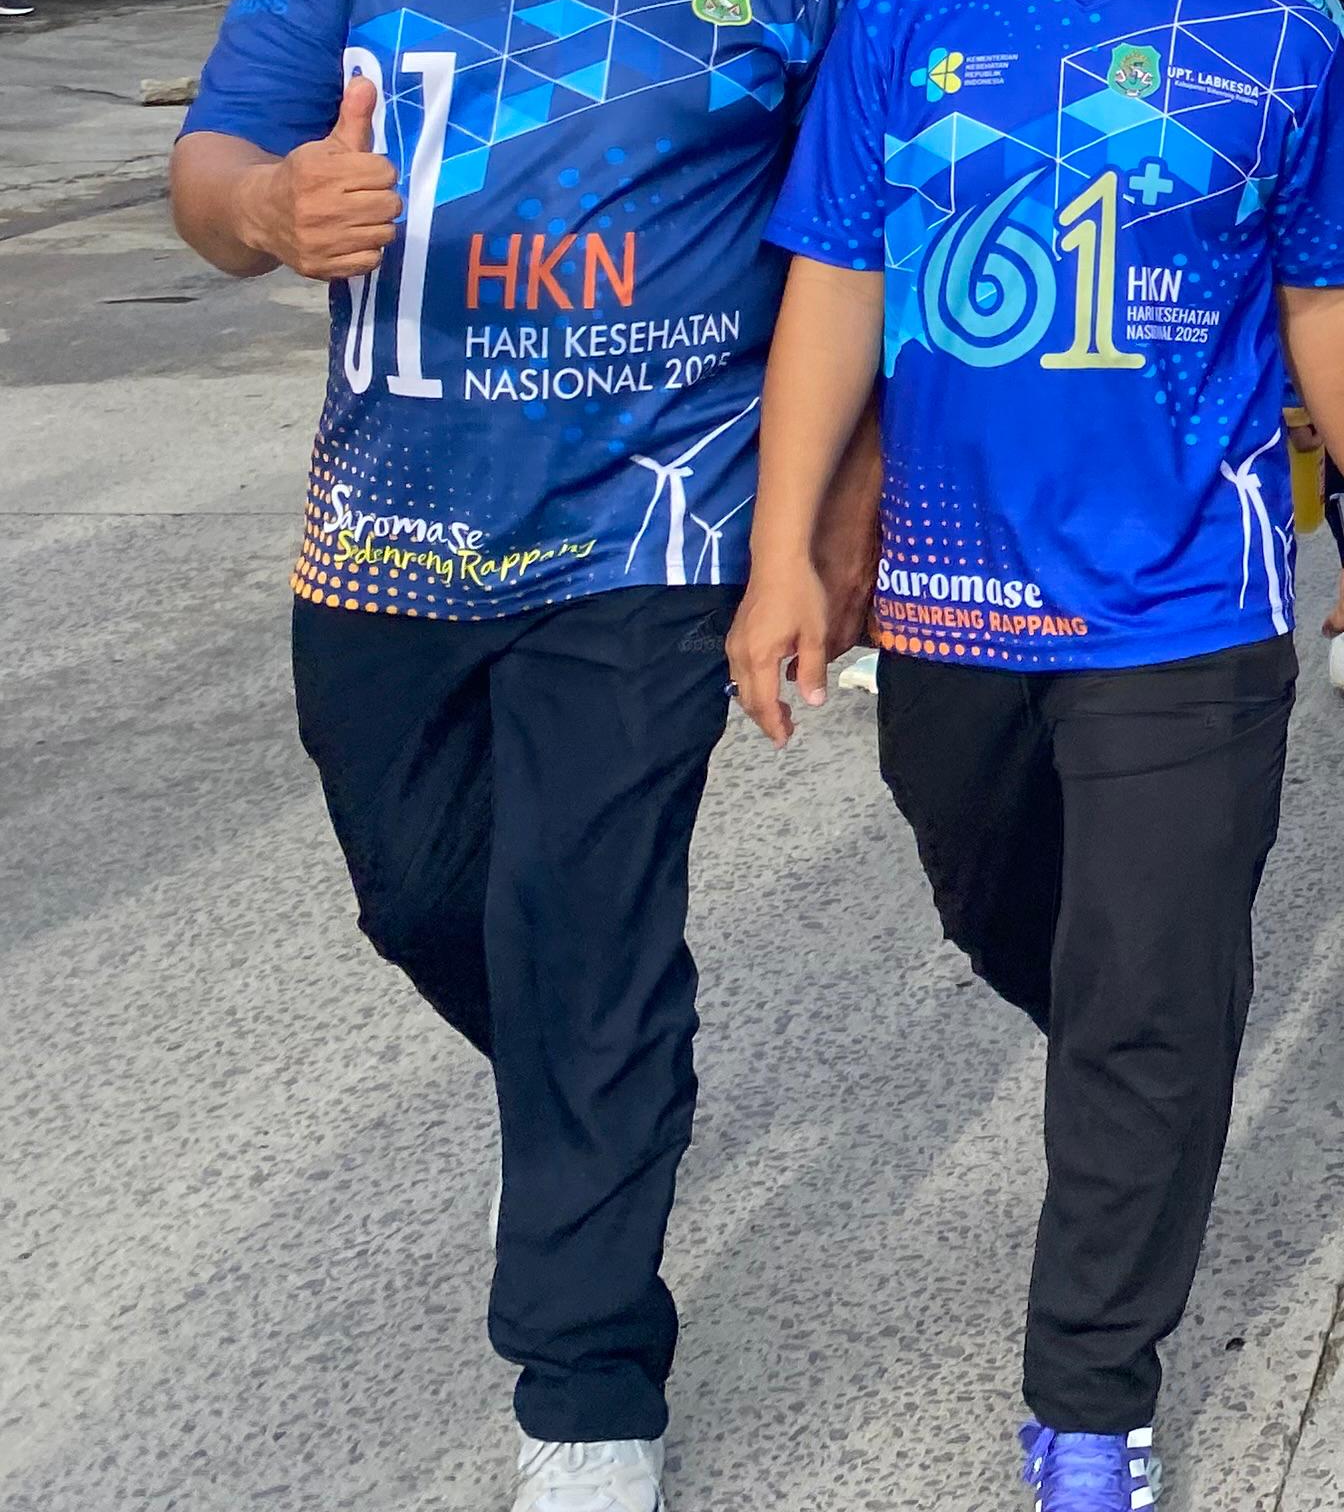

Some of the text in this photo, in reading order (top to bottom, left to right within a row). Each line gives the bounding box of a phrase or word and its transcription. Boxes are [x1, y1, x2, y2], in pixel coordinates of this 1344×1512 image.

[1197, 72, 1260, 99] LABKESDA
[465, 231, 636, 310] HKN
[1127, 266, 1183, 303] HKN
[465, 310, 740, 359] HARI KESEHATAN
[1174, 326, 1209, 343] 2025
[464, 361, 653, 401] NASIONAL
[323, 484, 484, 554] Saromase
[876, 558, 1044, 609] Saromase
[879, 597, 1089, 637] SIDENRENG RAPPANG
